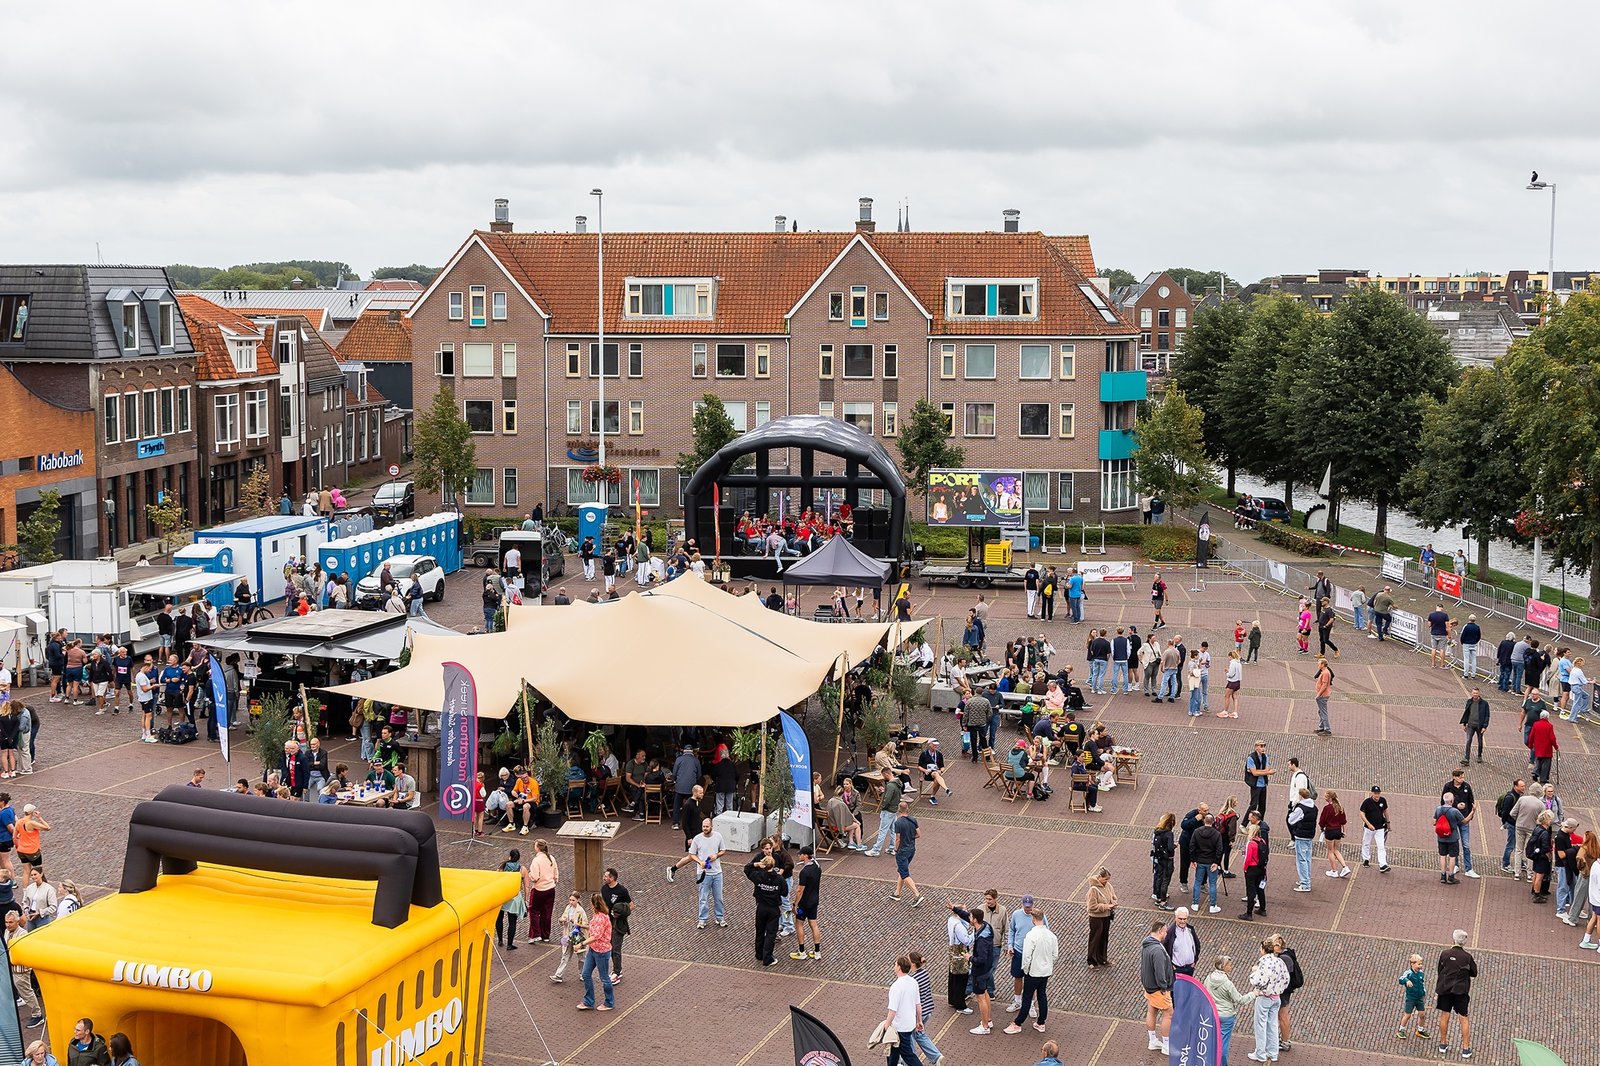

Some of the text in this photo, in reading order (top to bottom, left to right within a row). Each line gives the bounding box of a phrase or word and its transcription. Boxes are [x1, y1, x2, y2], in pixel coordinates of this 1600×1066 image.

[145, 442, 165, 455] Flynth
[567, 440, 614, 448] miedea
[604, 448, 660, 457] ccountants
[39, 449, 84, 471] Rabobank
[929, 473, 982, 487] PORT
[111, 960, 213, 992] JUMBO
